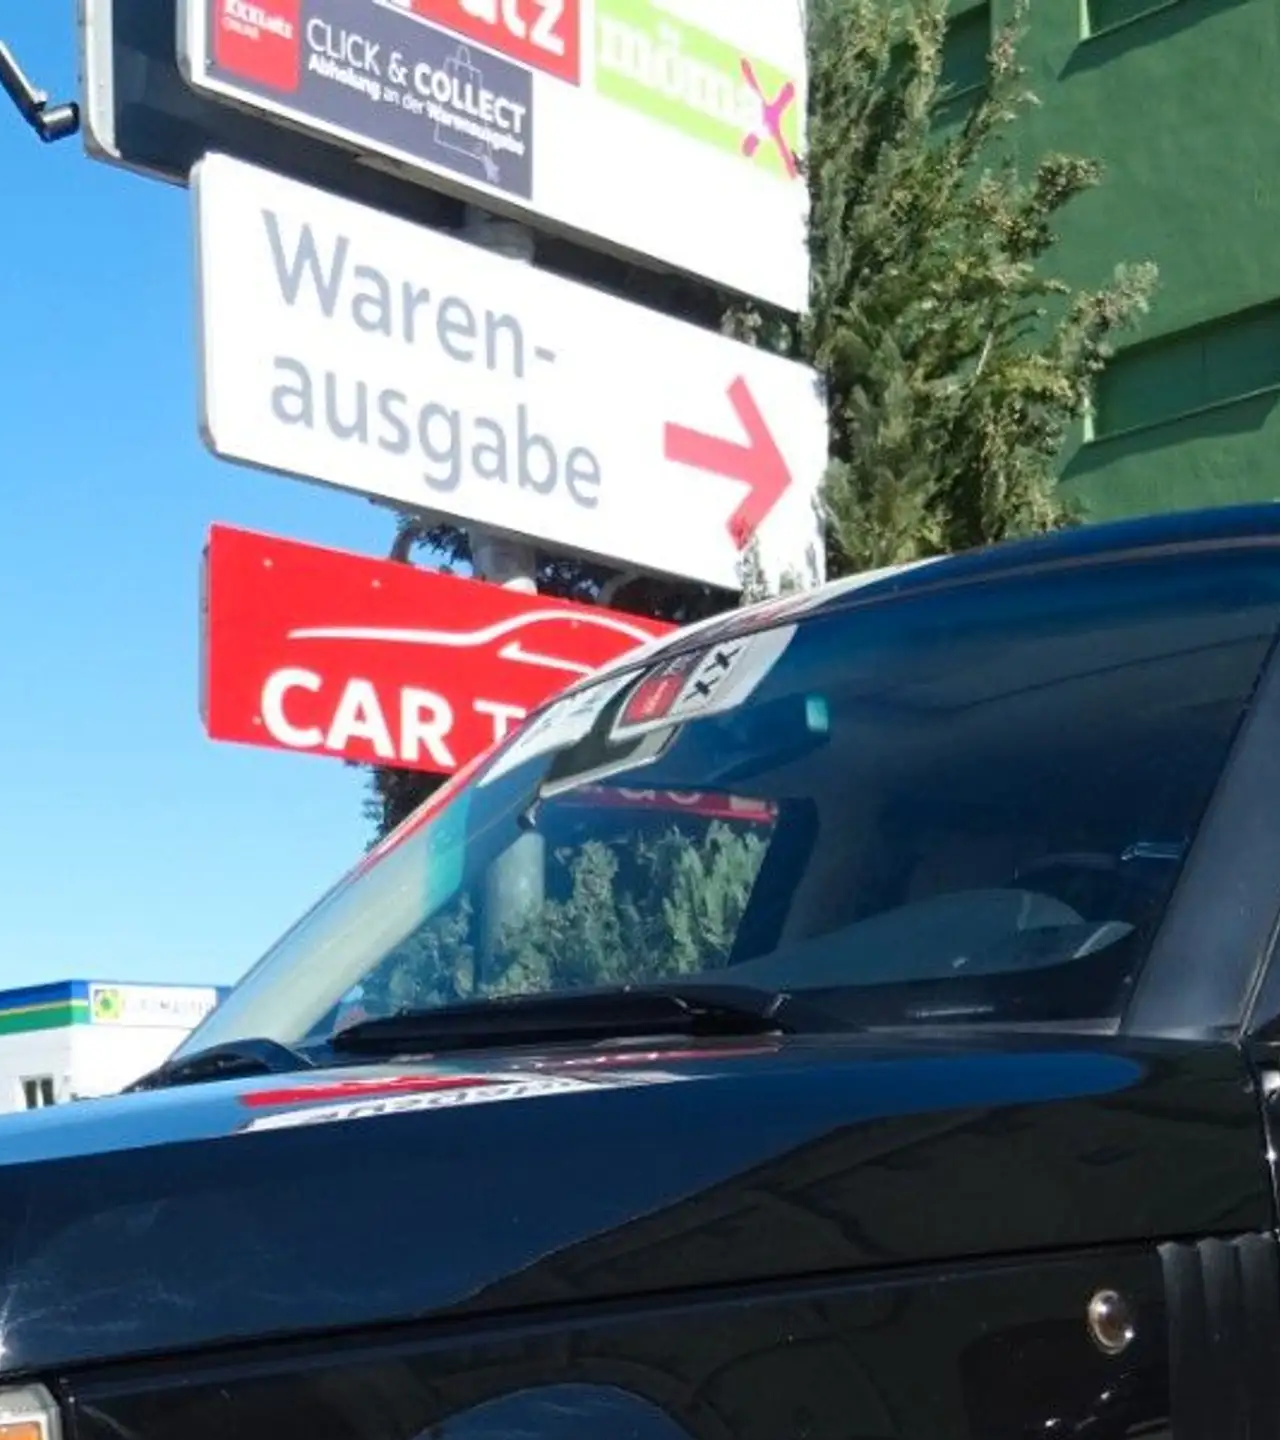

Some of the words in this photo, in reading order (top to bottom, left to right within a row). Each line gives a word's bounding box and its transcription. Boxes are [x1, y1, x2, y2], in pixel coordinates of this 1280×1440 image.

[305, 17, 382, 77] CLICK
[387, 51, 408, 86] &
[413, 62, 526, 134] COLLECT
[307, 53, 382, 101] Abholung
[260, 208, 558, 379] Waren-
[270, 354, 603, 509] ausgabe
[261, 667, 456, 768] CAR
[472, 698, 528, 750] T
